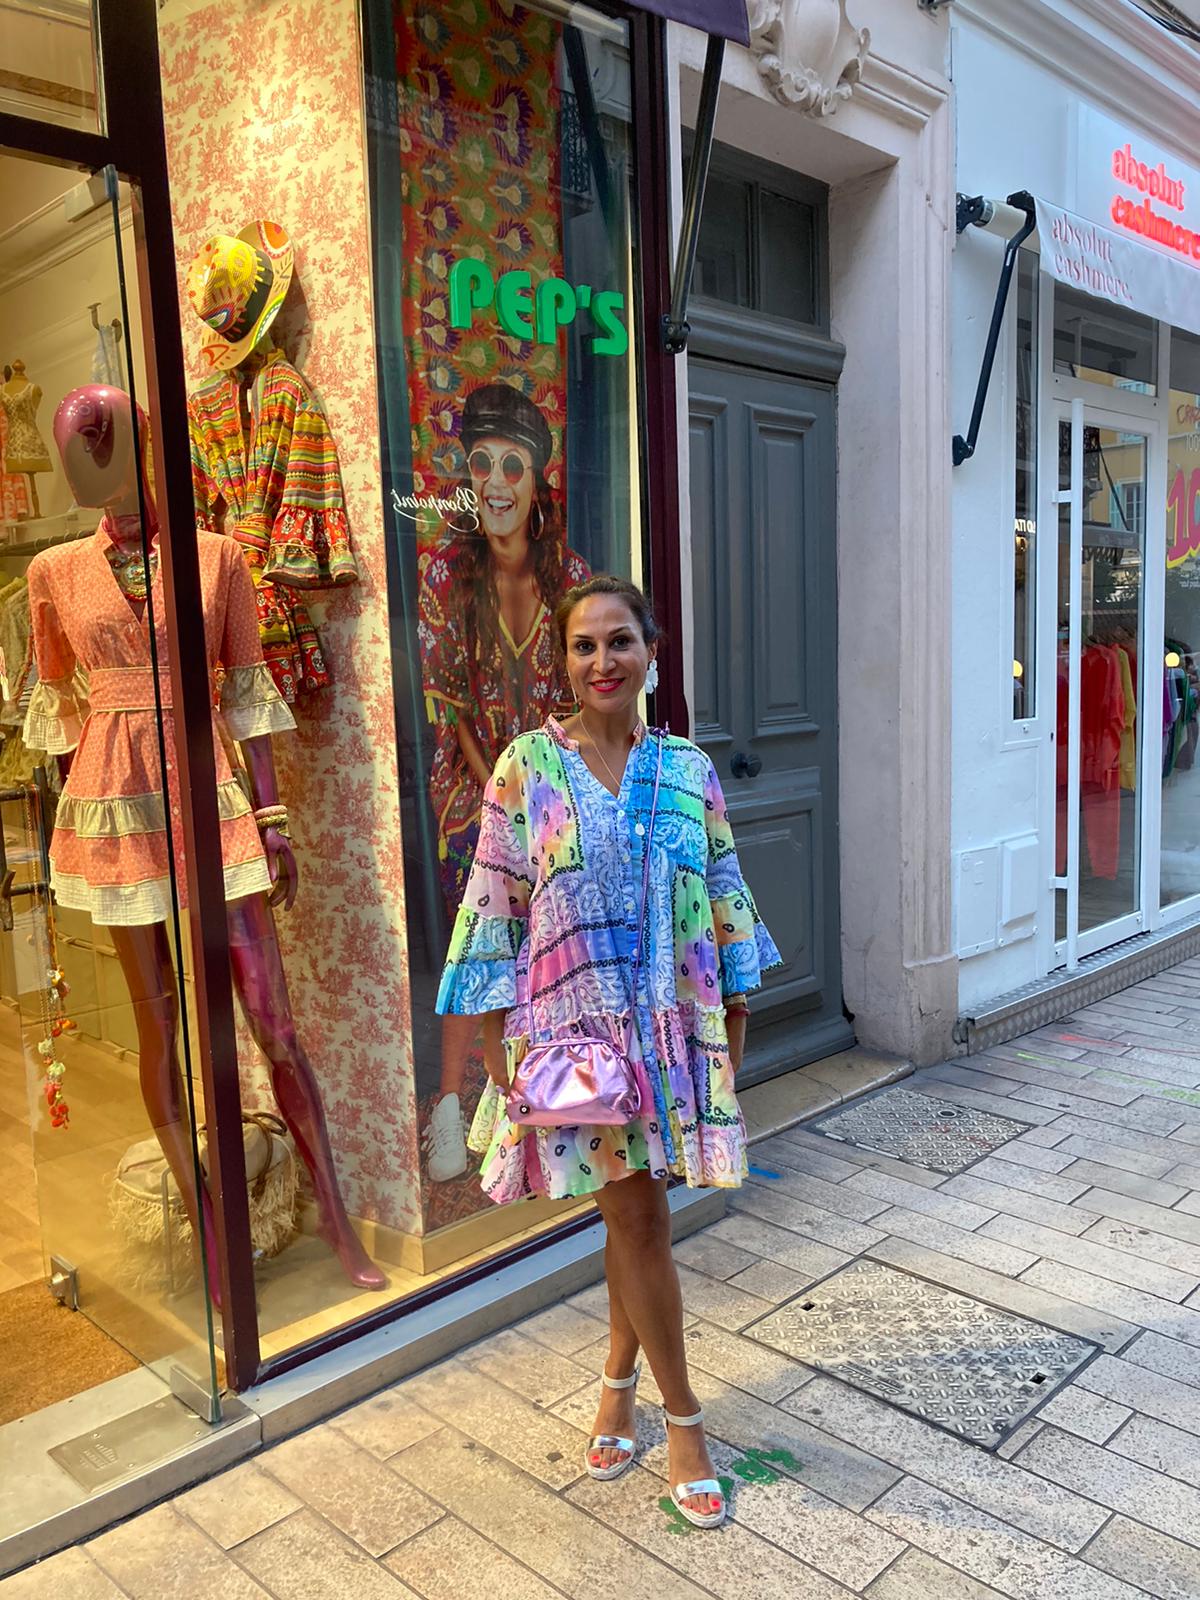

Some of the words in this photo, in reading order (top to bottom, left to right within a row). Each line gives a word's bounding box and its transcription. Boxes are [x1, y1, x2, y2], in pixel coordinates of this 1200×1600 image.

[1111, 143, 1185, 211] absolut
[1053, 213, 1113, 263] absolut
[1110, 195, 1200, 260] cashmere
[1055, 254, 1133, 301] cashmere.
[450, 257, 629, 357] PEP'S
[1186, 434, 1200, 453] 100
